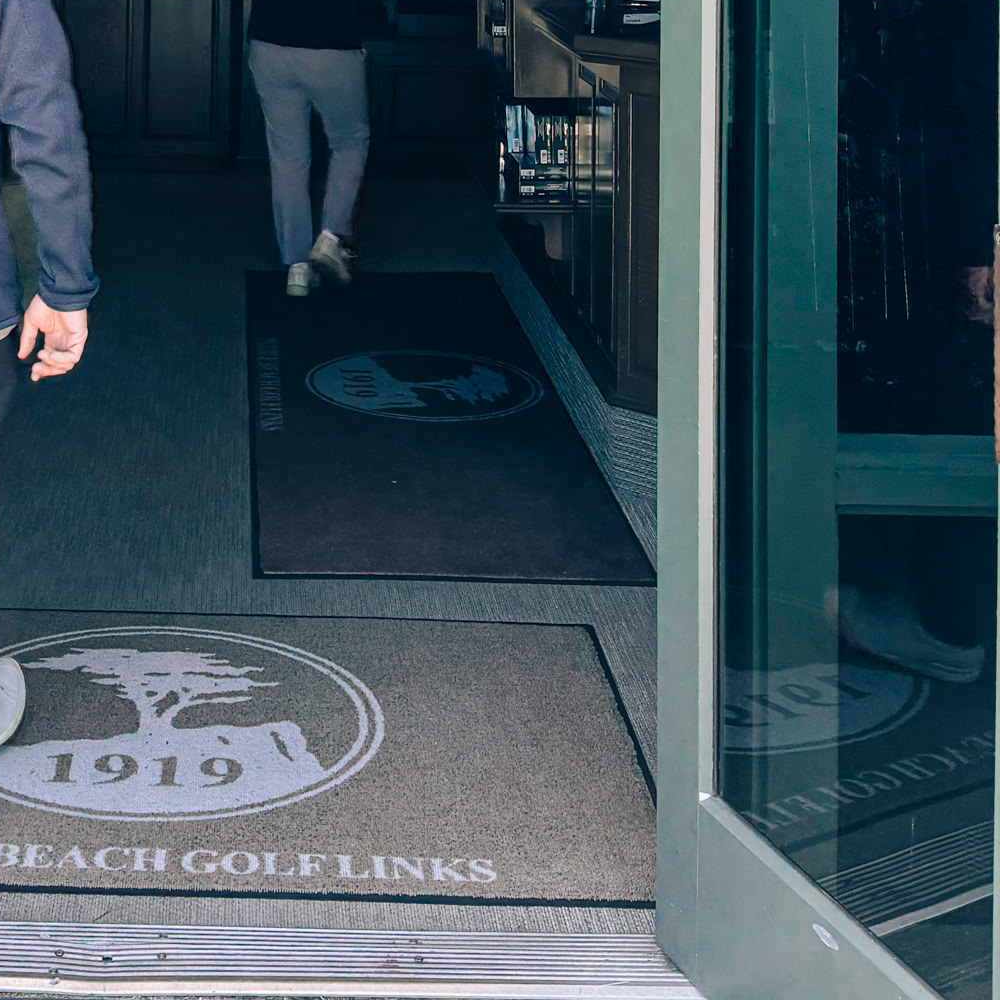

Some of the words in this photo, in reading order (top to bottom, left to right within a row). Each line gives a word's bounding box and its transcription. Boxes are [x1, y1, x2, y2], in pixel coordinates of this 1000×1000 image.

[42, 753, 244, 788] 1919
[181, 850, 326, 877] GOLF
[339, 855, 498, 883] LINKS
